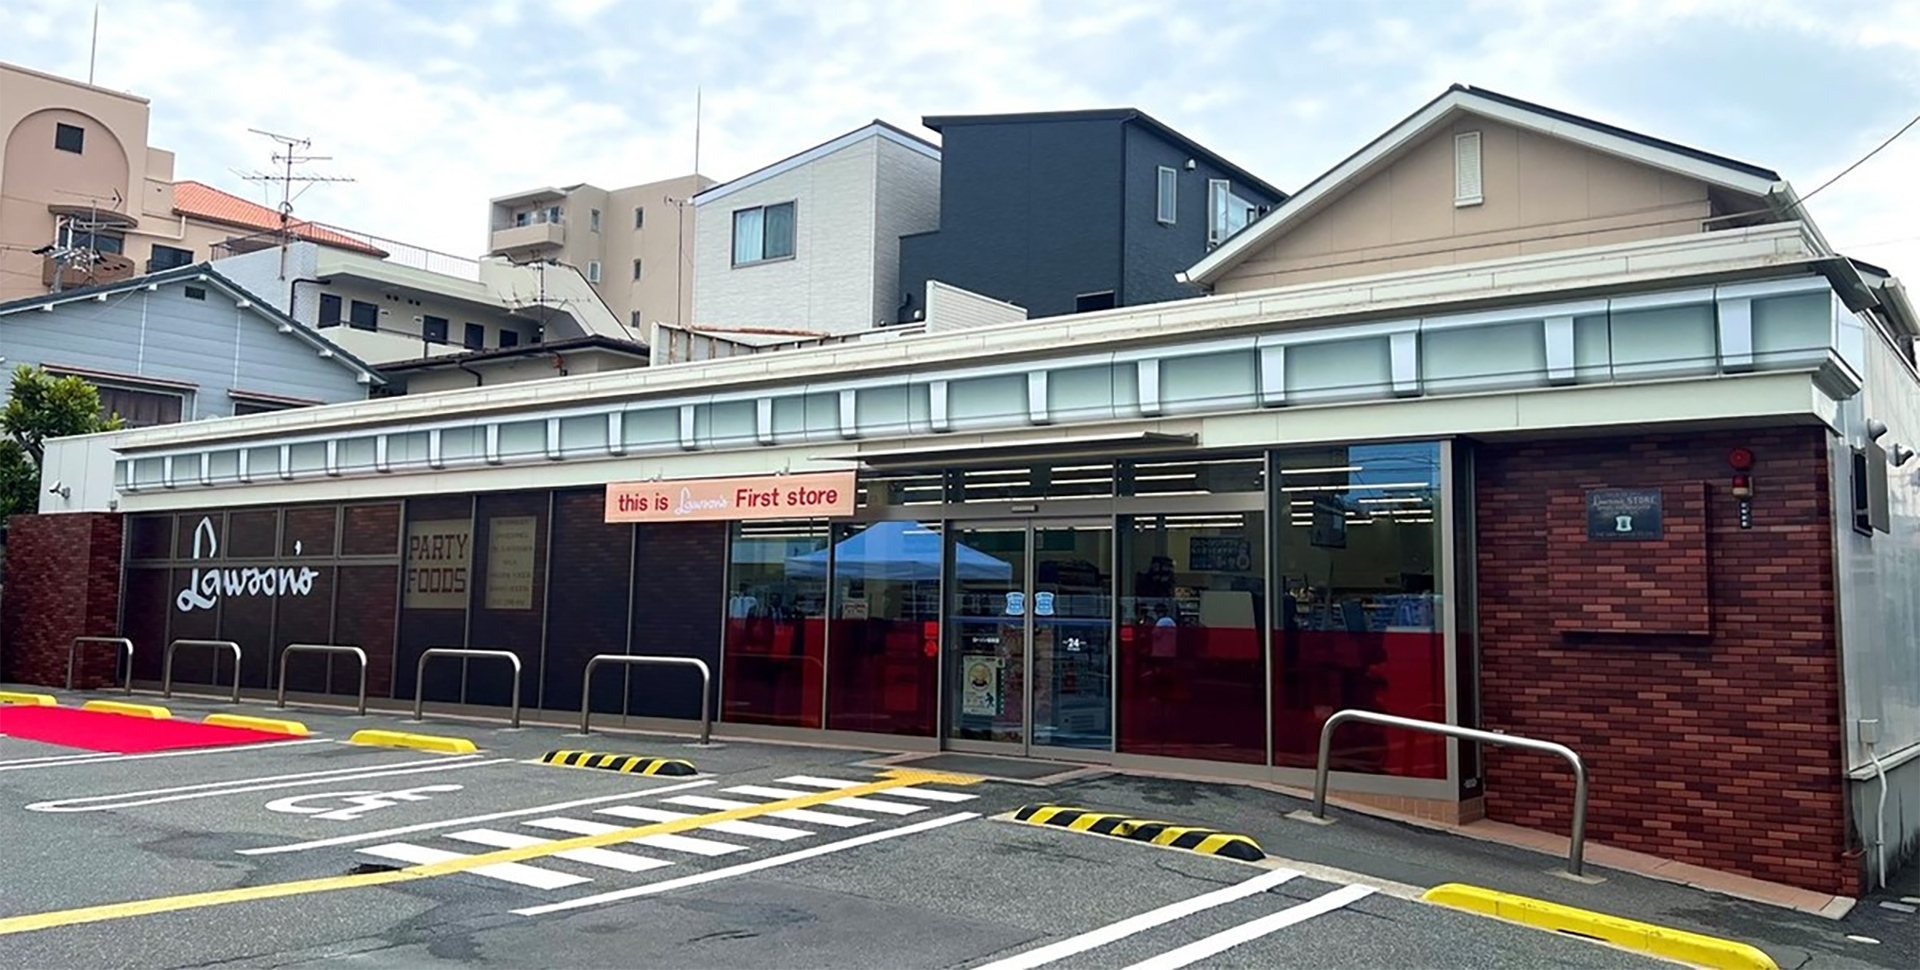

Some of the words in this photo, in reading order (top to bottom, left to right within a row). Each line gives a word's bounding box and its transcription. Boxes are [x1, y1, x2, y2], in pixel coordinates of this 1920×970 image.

[618, 494, 648, 512] this
[655, 493, 668, 510] is
[736, 488, 779, 508] First
[786, 486, 838, 505] store
[409, 533, 468, 560] PARTY
[177, 516, 319, 611] Lawson's
[406, 567, 466, 593] FOODS
